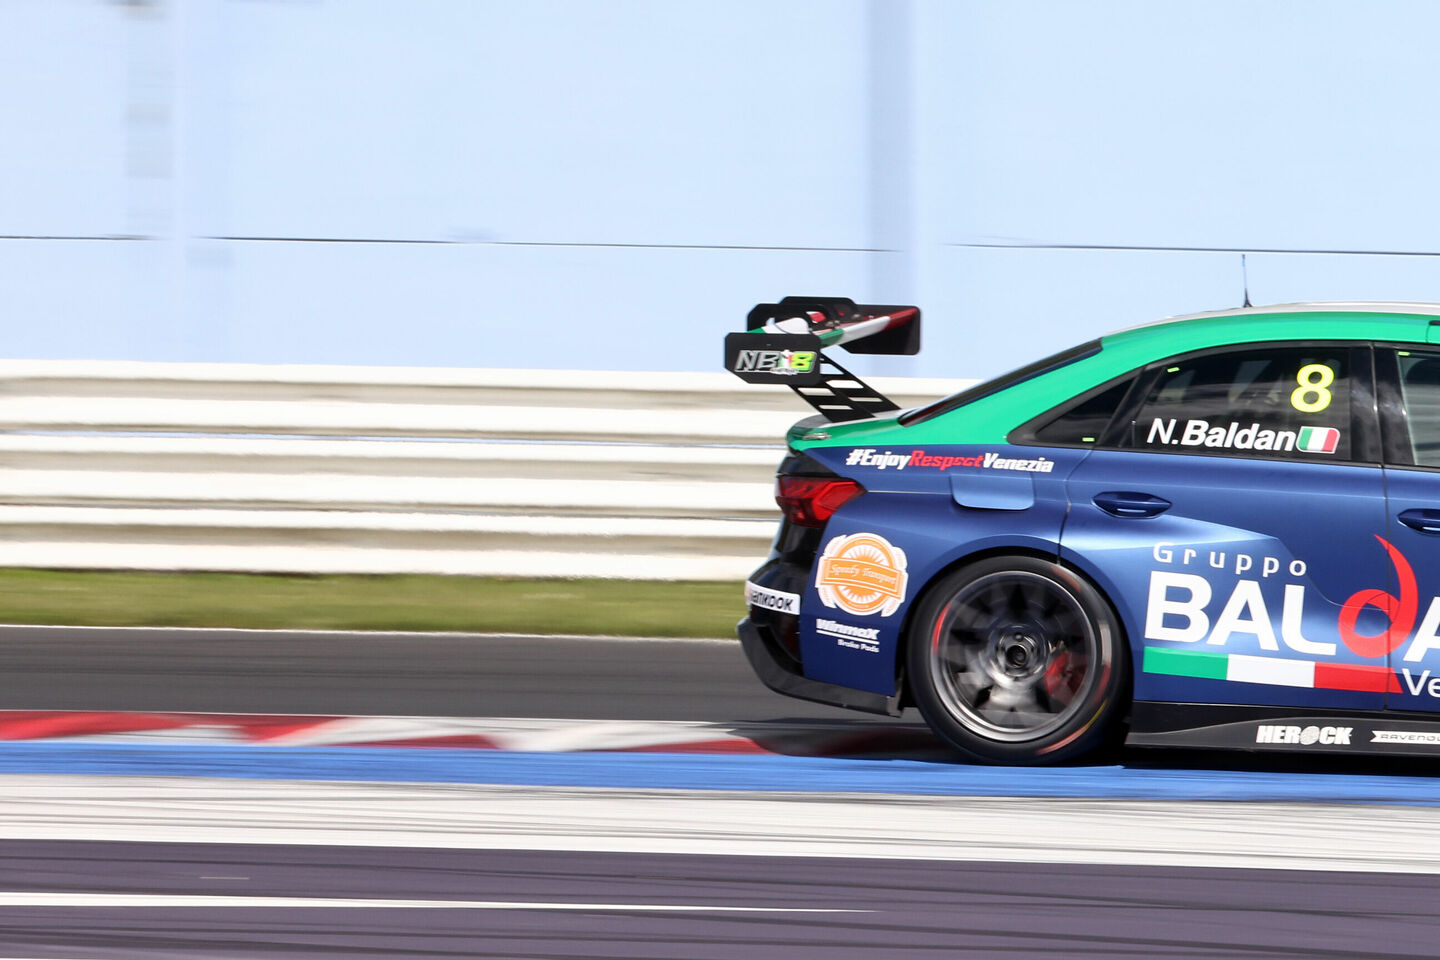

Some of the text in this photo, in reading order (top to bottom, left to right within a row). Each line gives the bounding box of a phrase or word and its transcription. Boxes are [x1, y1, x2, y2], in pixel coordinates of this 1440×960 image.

[1290, 363, 1335, 413] 8
[1146, 417, 1297, 452] N.Baldan
[1152, 541, 1307, 577] Gruppo
